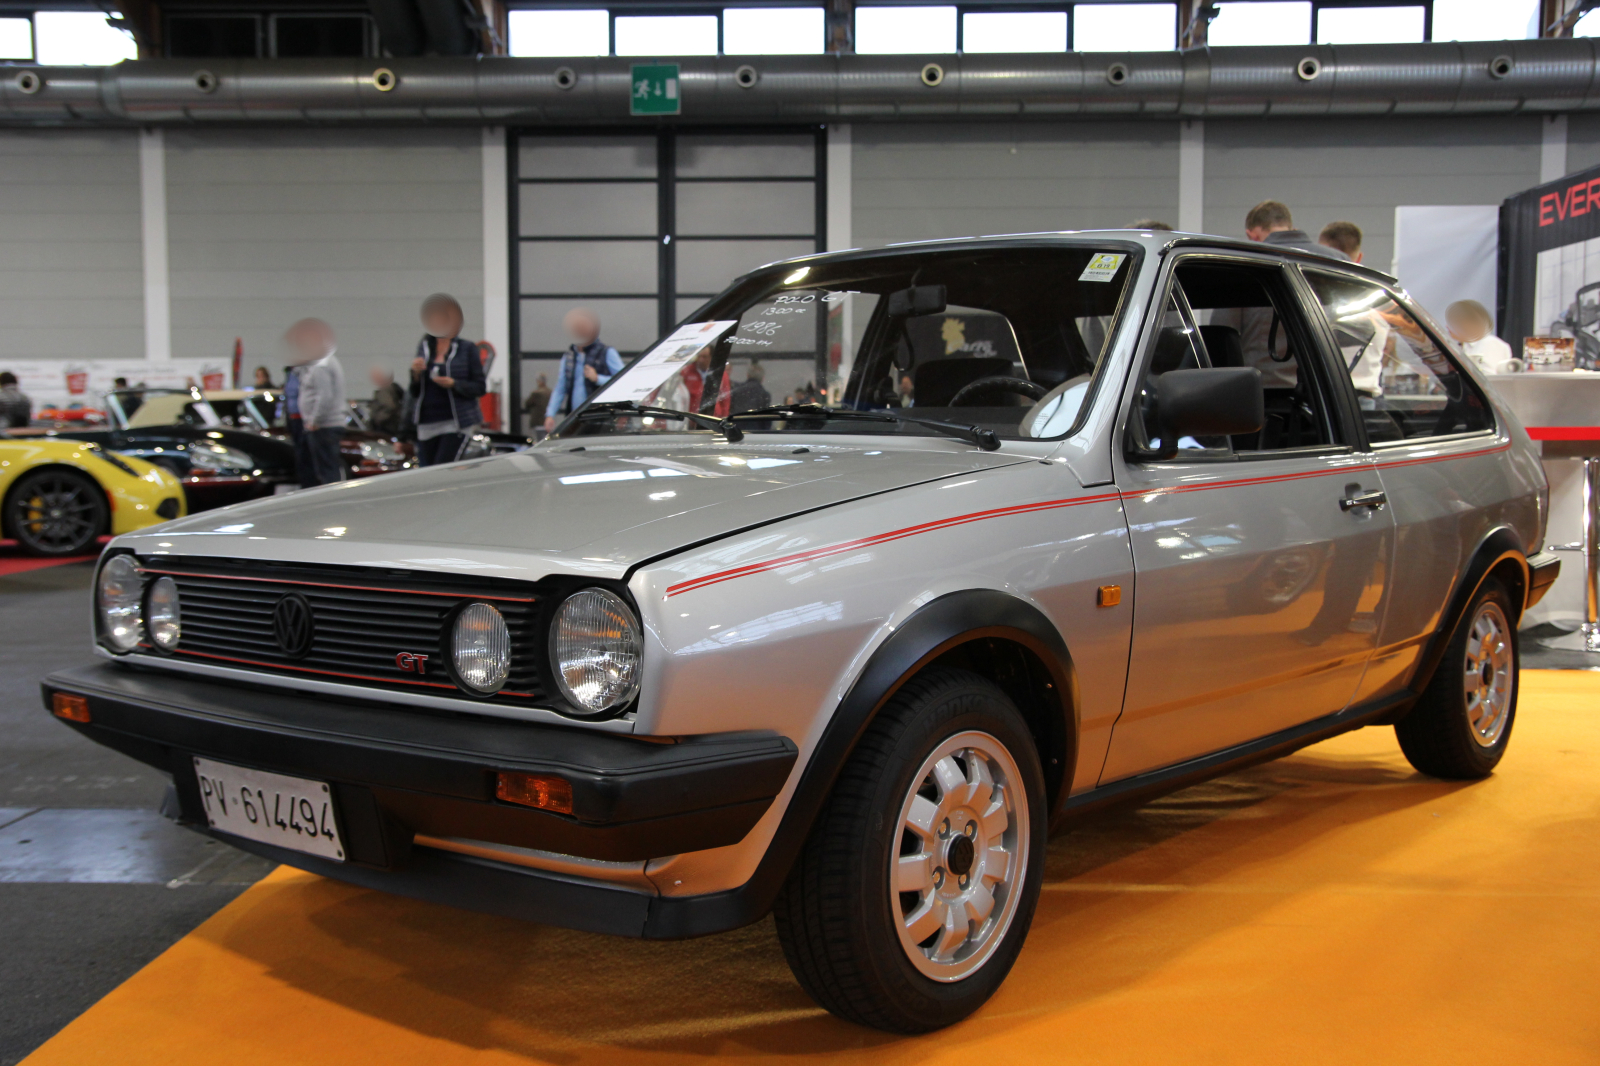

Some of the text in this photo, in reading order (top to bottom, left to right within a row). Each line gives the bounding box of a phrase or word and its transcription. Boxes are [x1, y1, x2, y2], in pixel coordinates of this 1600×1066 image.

[774, 290, 861, 305] POLO GT
[761, 307, 793, 316] 1300
[741, 321, 782, 336] 1986
[395, 652, 429, 674] GT
[200, 775, 335, 841] PV 614494
